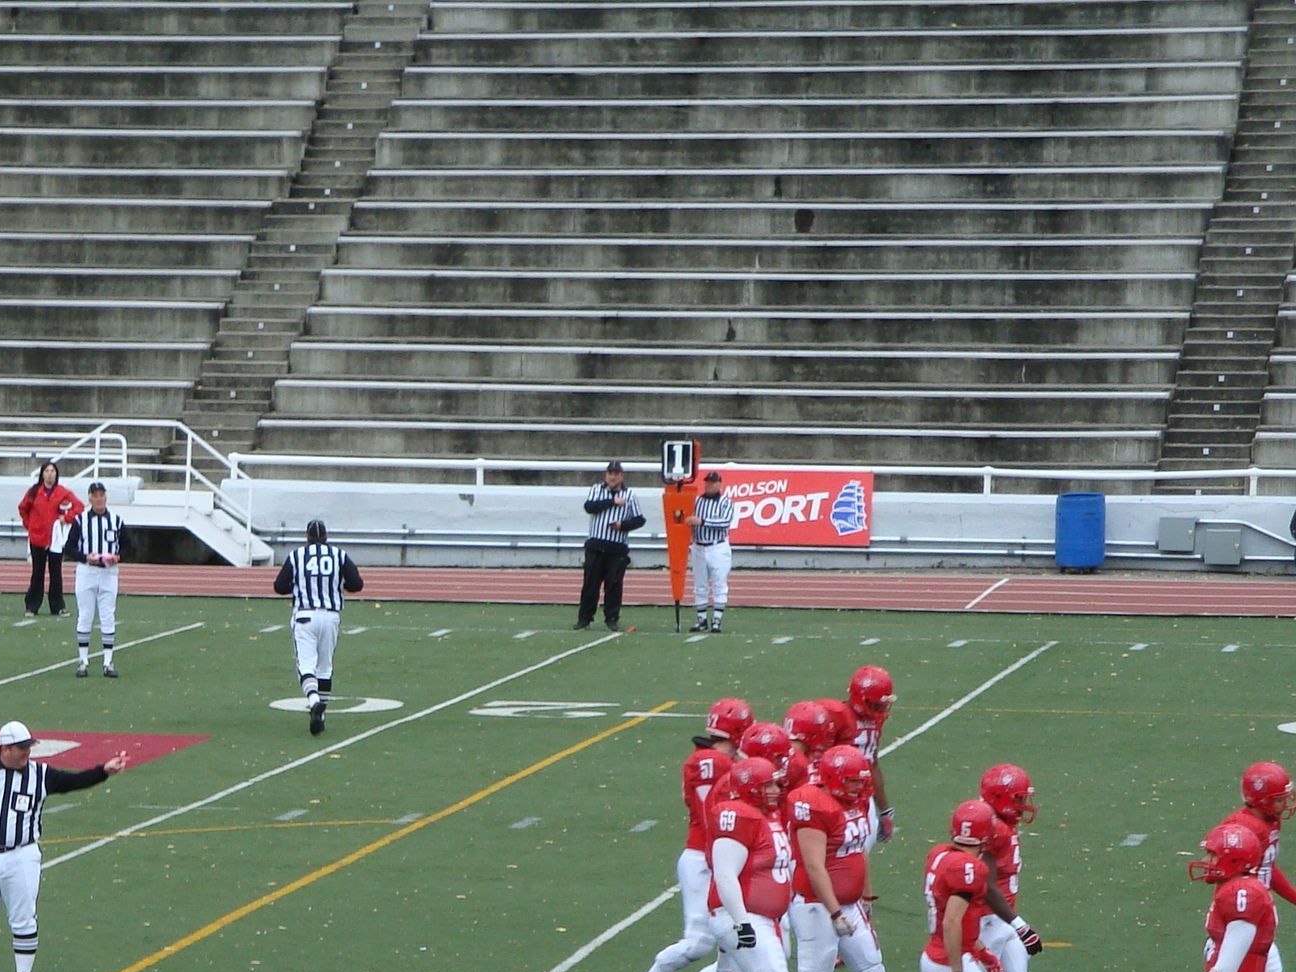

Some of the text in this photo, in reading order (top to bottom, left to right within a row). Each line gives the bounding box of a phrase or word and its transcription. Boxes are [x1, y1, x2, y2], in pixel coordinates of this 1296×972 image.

[672, 444, 685, 475] 1
[724, 479, 788, 498] MOLSON
[729, 491, 830, 530] PORT
[306, 555, 333, 575] 40
[719, 810, 736, 832] 69
[964, 863, 974, 885] 5
[1235, 889, 1247, 912] 6
